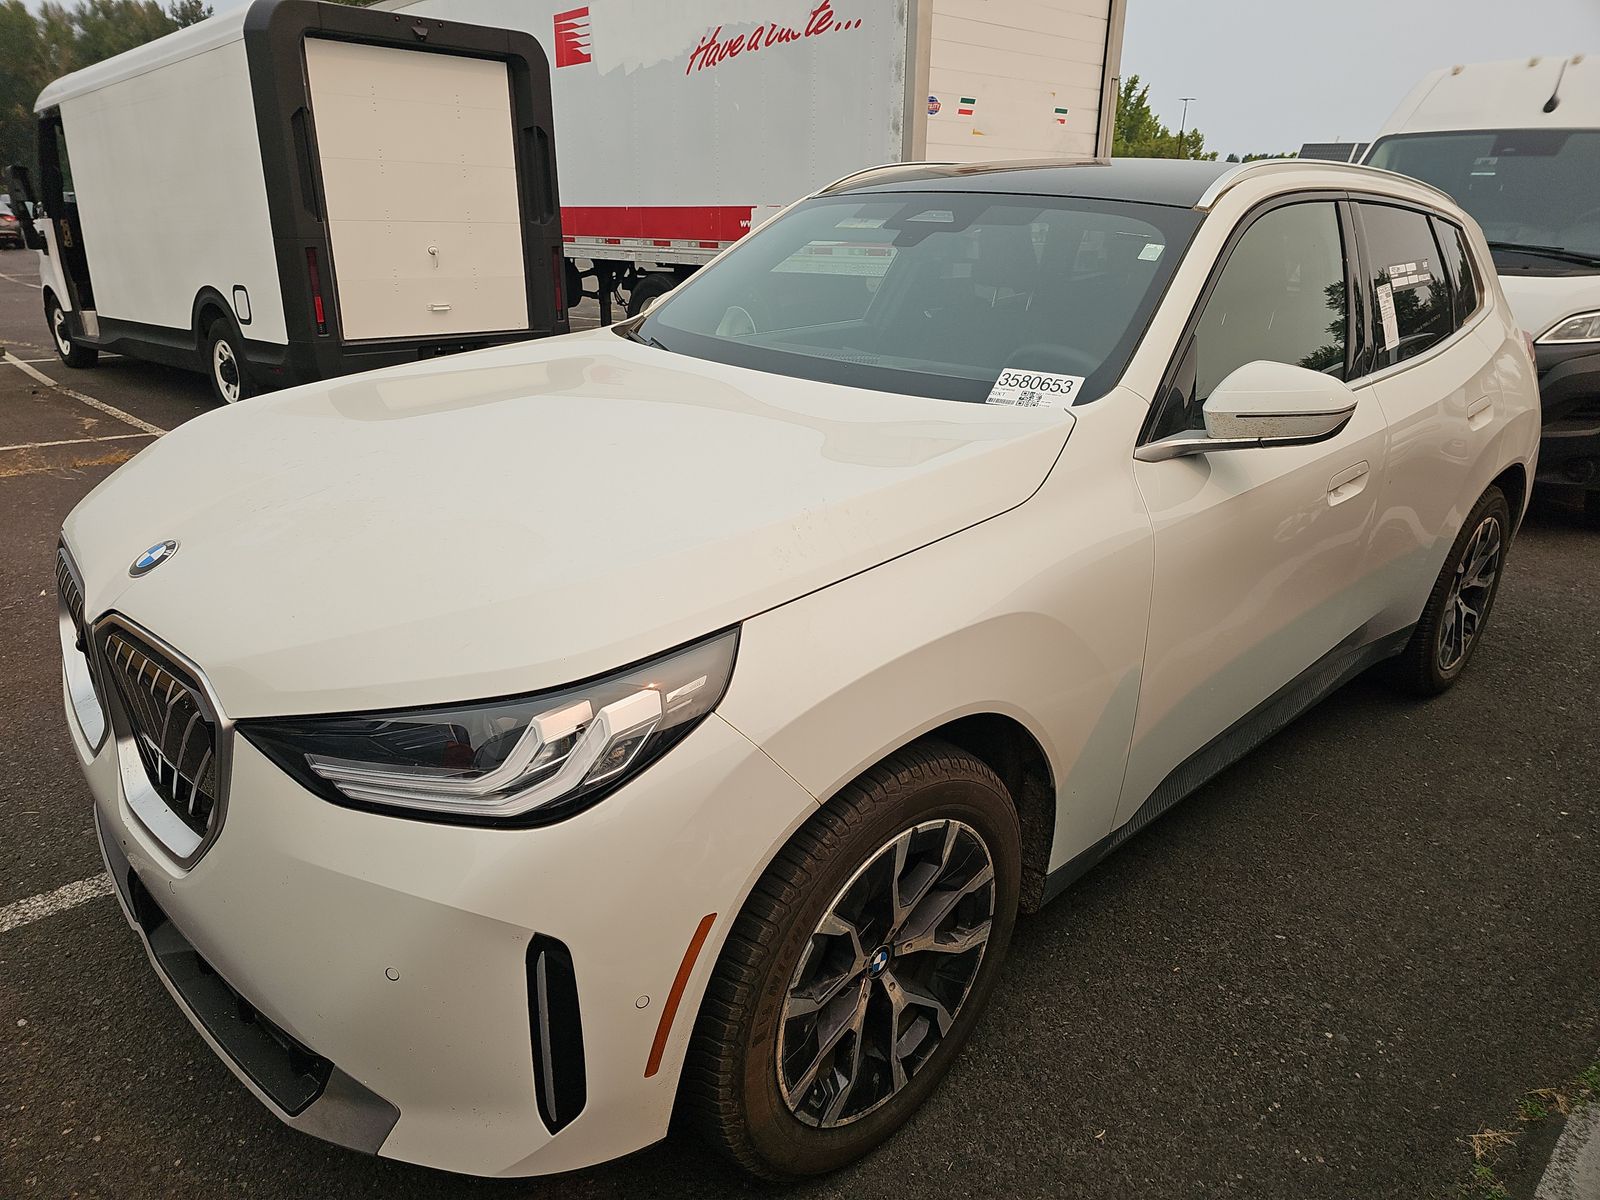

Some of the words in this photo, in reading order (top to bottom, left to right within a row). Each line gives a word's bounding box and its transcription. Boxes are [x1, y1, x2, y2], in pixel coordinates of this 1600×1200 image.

[685, 25, 745, 76] Have
[746, 26, 764, 51] a
[998, 372, 1074, 394] 3580653
